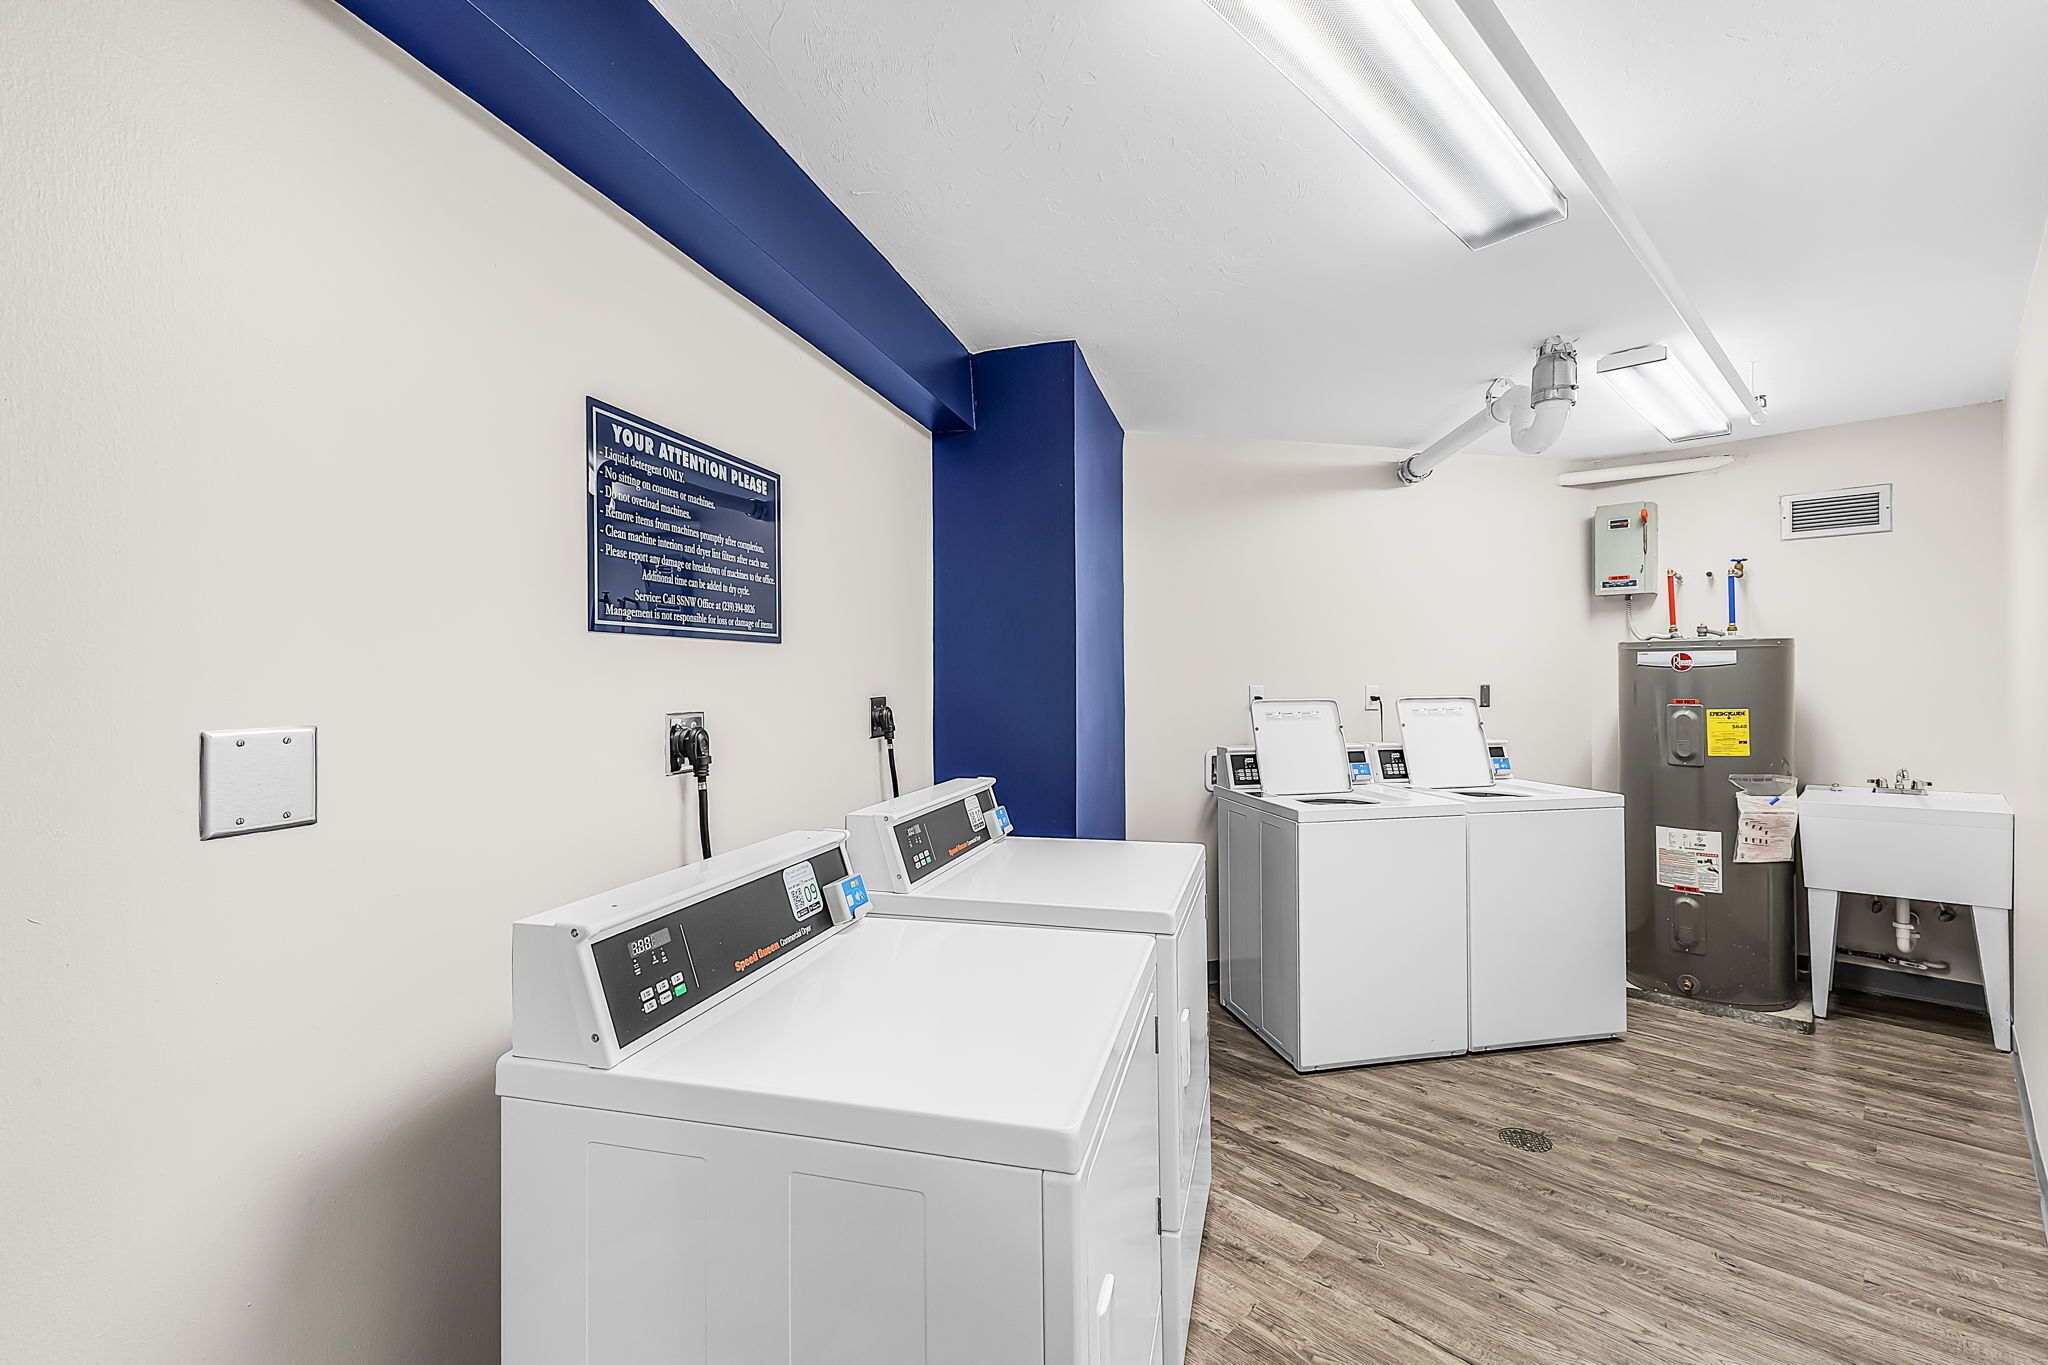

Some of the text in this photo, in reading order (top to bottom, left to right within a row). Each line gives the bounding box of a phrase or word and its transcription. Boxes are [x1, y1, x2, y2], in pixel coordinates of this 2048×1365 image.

[604, 446, 685, 484] Liquid detergent ONLY.
[612, 423, 768, 496] YOUR ATTENTION PLEASE
[604, 466, 716, 510] No sitting on counters or machines.
[604, 485, 692, 519] Do not overload machines.
[604, 504, 764, 554] Remove items from machines promptly after completion.
[605, 524, 770, 570] Clean machine interiors and dryer lint filters after each use.
[604, 543, 776, 585] Please report any damage or breakdown of machines to the office.
[642, 568, 750, 598] Additional time can be added to dry cycle.
[604, 604, 774, 630] Management is not responsible for loss or damage of items
[634, 590, 662, 602] Service:
[662, 593, 676, 604] Call
[676, 594, 696, 607] SSNW
[696, 598, 714, 610] Office
[716, 601, 722, 610] at
[1673, 653, 1694, 668] Rheem
[804, 883, 818, 903] 09
[734, 950, 759, 972] Speed
[758, 942, 780, 960] Queen
[780, 929, 802, 947] Commercial
